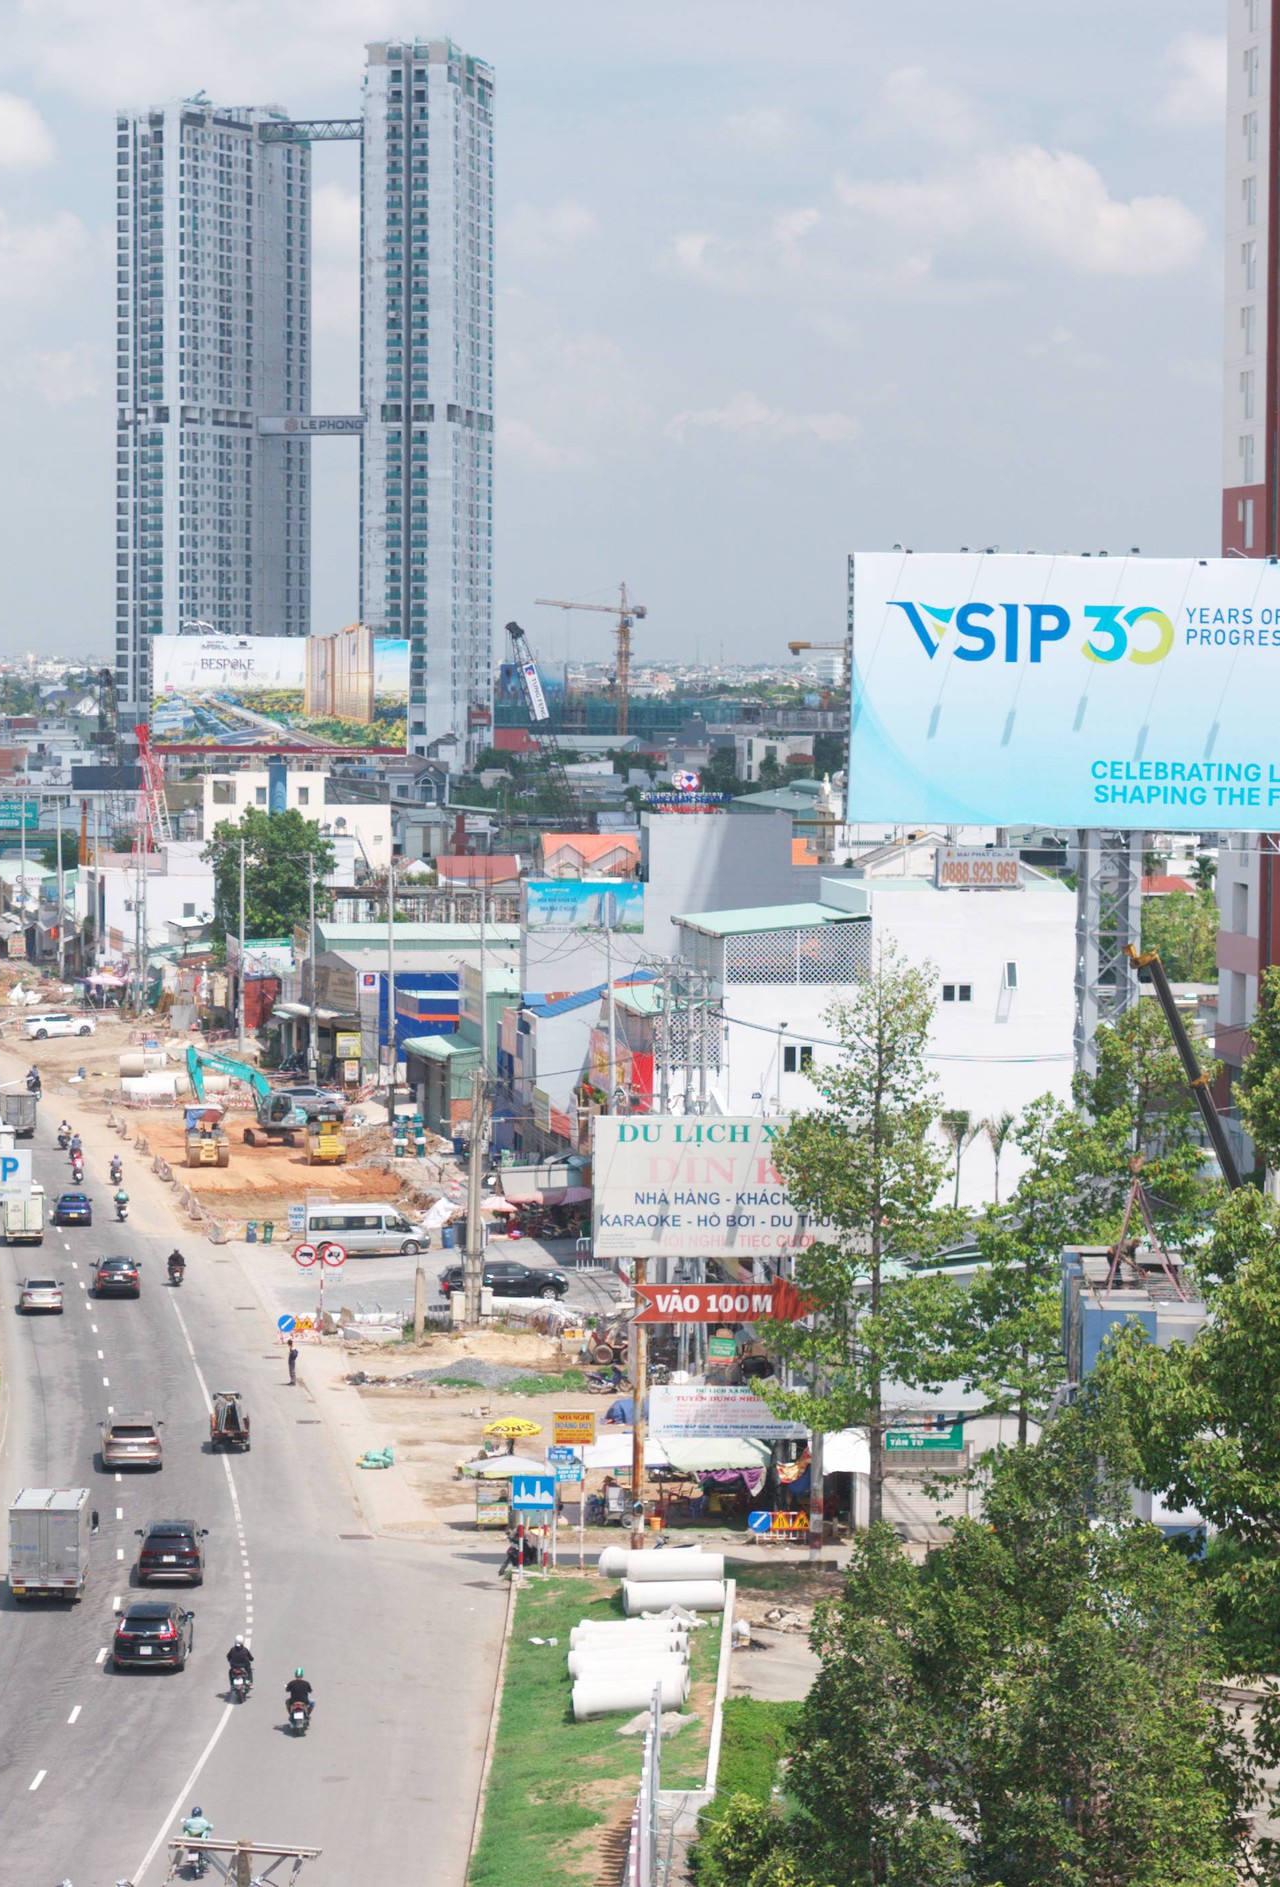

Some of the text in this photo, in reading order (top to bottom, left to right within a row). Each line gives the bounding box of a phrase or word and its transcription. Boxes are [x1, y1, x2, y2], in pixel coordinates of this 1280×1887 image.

[300, 420, 365, 430] LE PHONG
[1186, 607, 1253, 625] YEARS
[885, 602, 1175, 666] VSIP 30
[1186, 628, 1280, 646] PROGRES
[1091, 760, 1261, 783] CELEBRATING
[1094, 784, 1207, 806] SHAPING
[1213, 786, 1261, 806] THE
[942, 861, 1017, 884] 0888.929.969
[616, 1123, 663, 1143] DU
[673, 1124, 751, 1148] LỊCH
[645, 1150, 737, 1184] DÌN
[634, 1189, 669, 1205] NHÀ
[673, 1189, 721, 1205] HÀNG
[600, 1213, 682, 1227] KARAOKE
[726, 1213, 756, 1228] BƠI
[770, 1214, 793, 1227] DU
